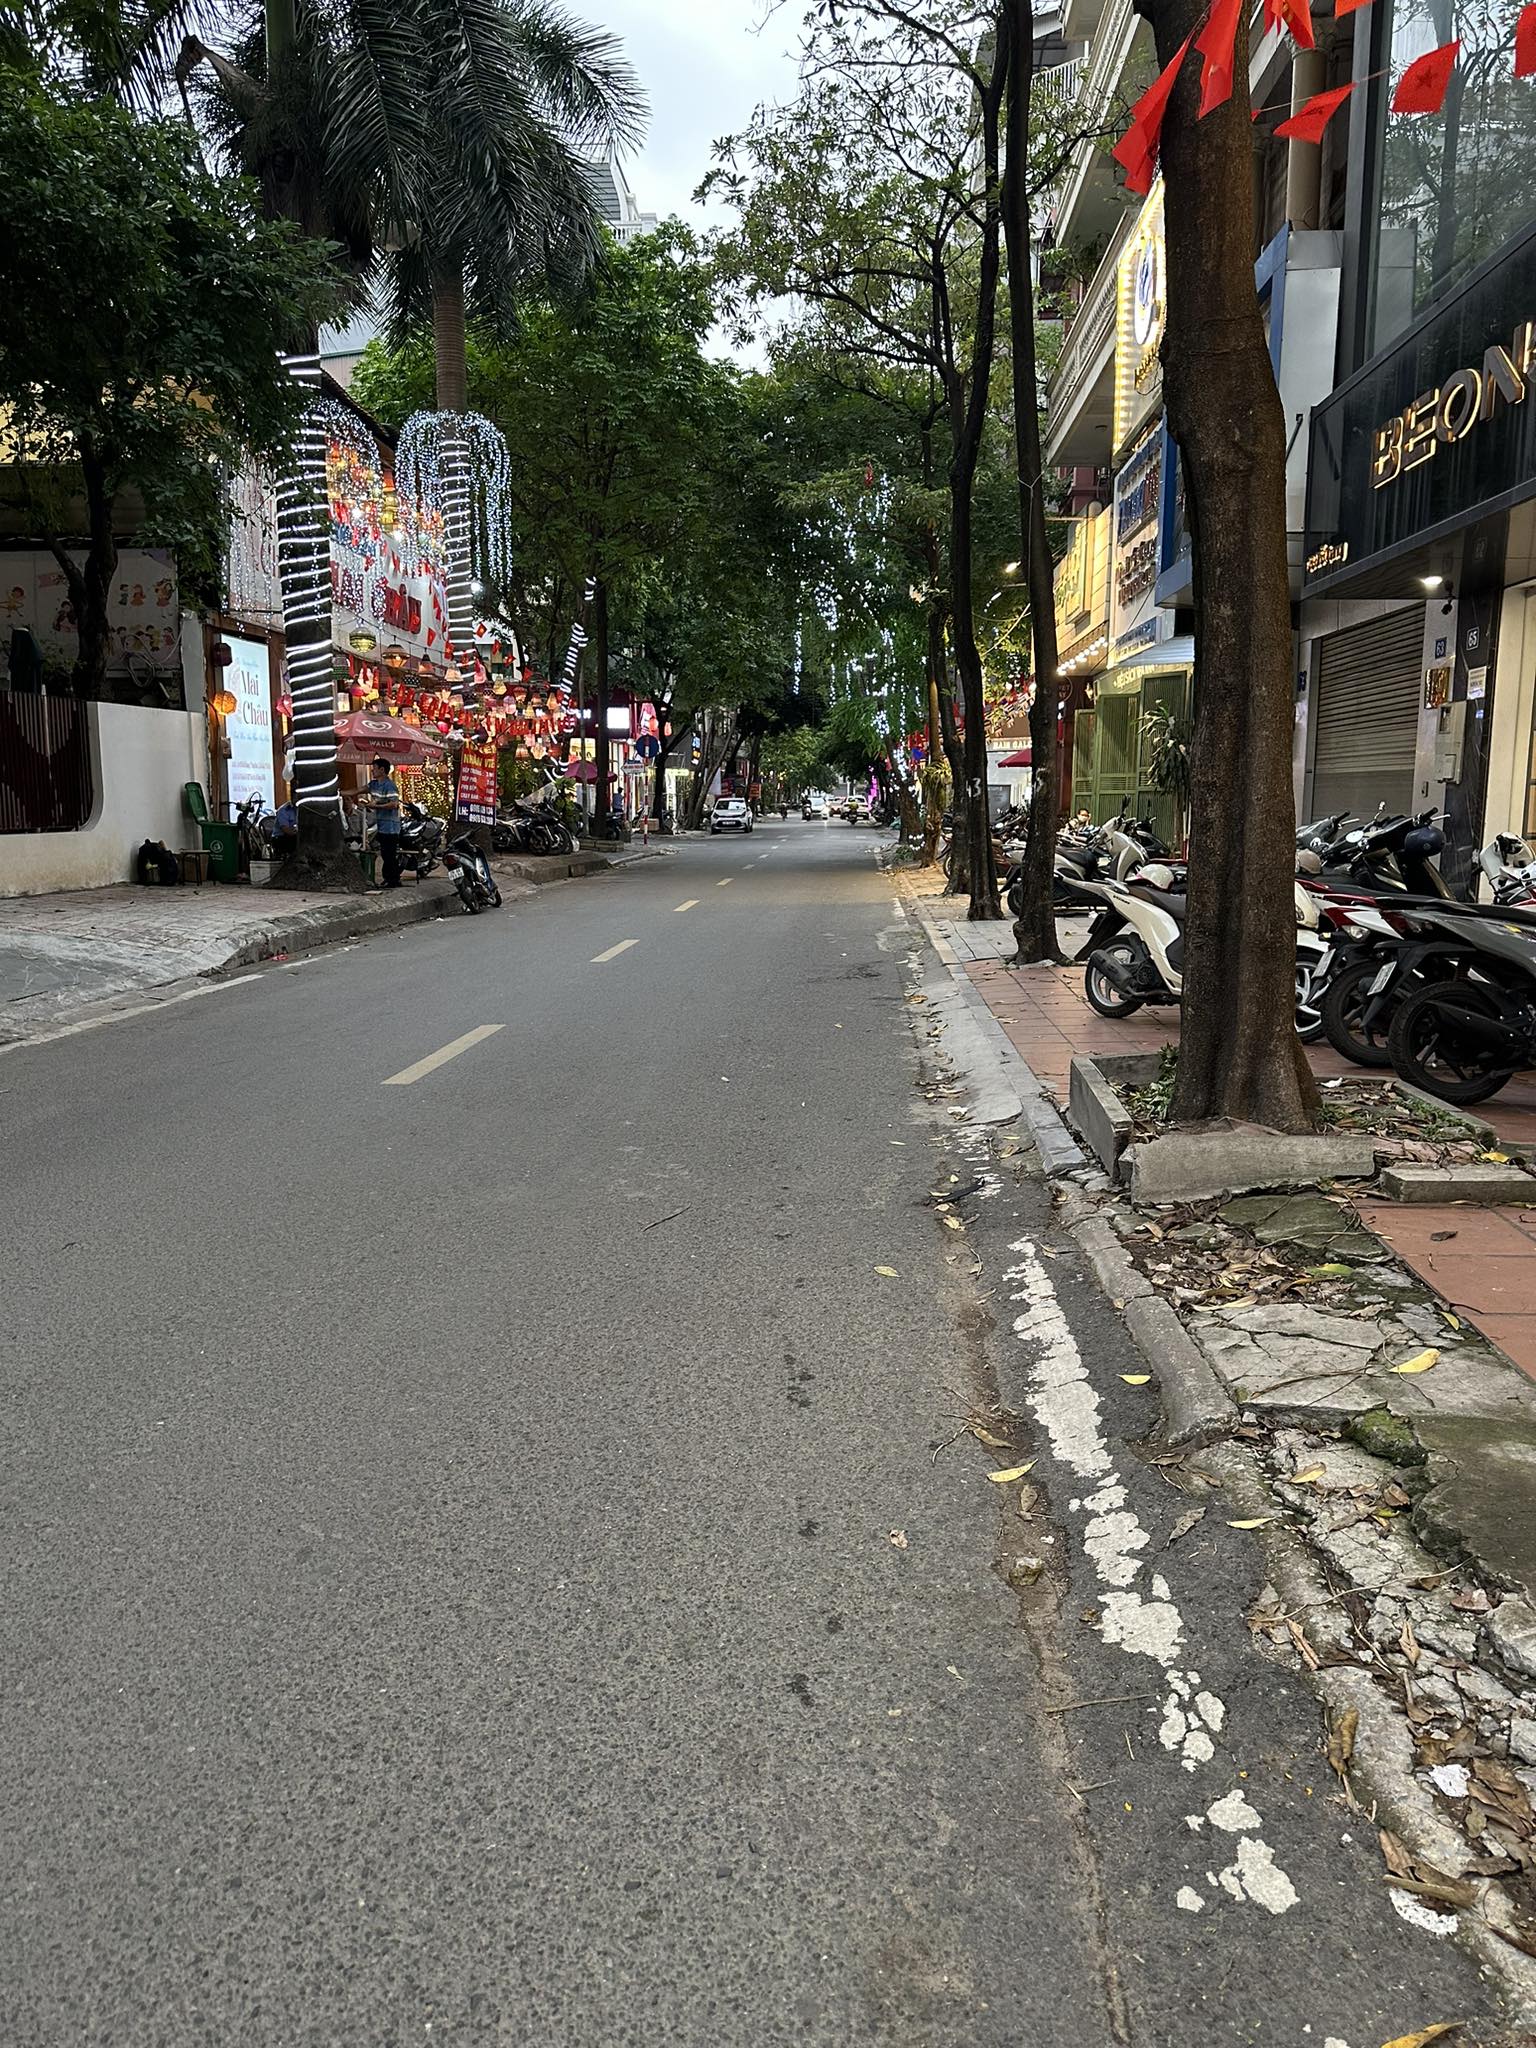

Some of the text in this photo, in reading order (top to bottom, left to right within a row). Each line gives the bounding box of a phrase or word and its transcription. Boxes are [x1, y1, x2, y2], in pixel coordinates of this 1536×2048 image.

[1468, 630, 1477, 648] 65
[241, 670, 259, 697] Mai
[242, 700, 268, 726] Châu
[369, 741, 395, 749] WALL'S
[965, 777, 981, 798] 43
